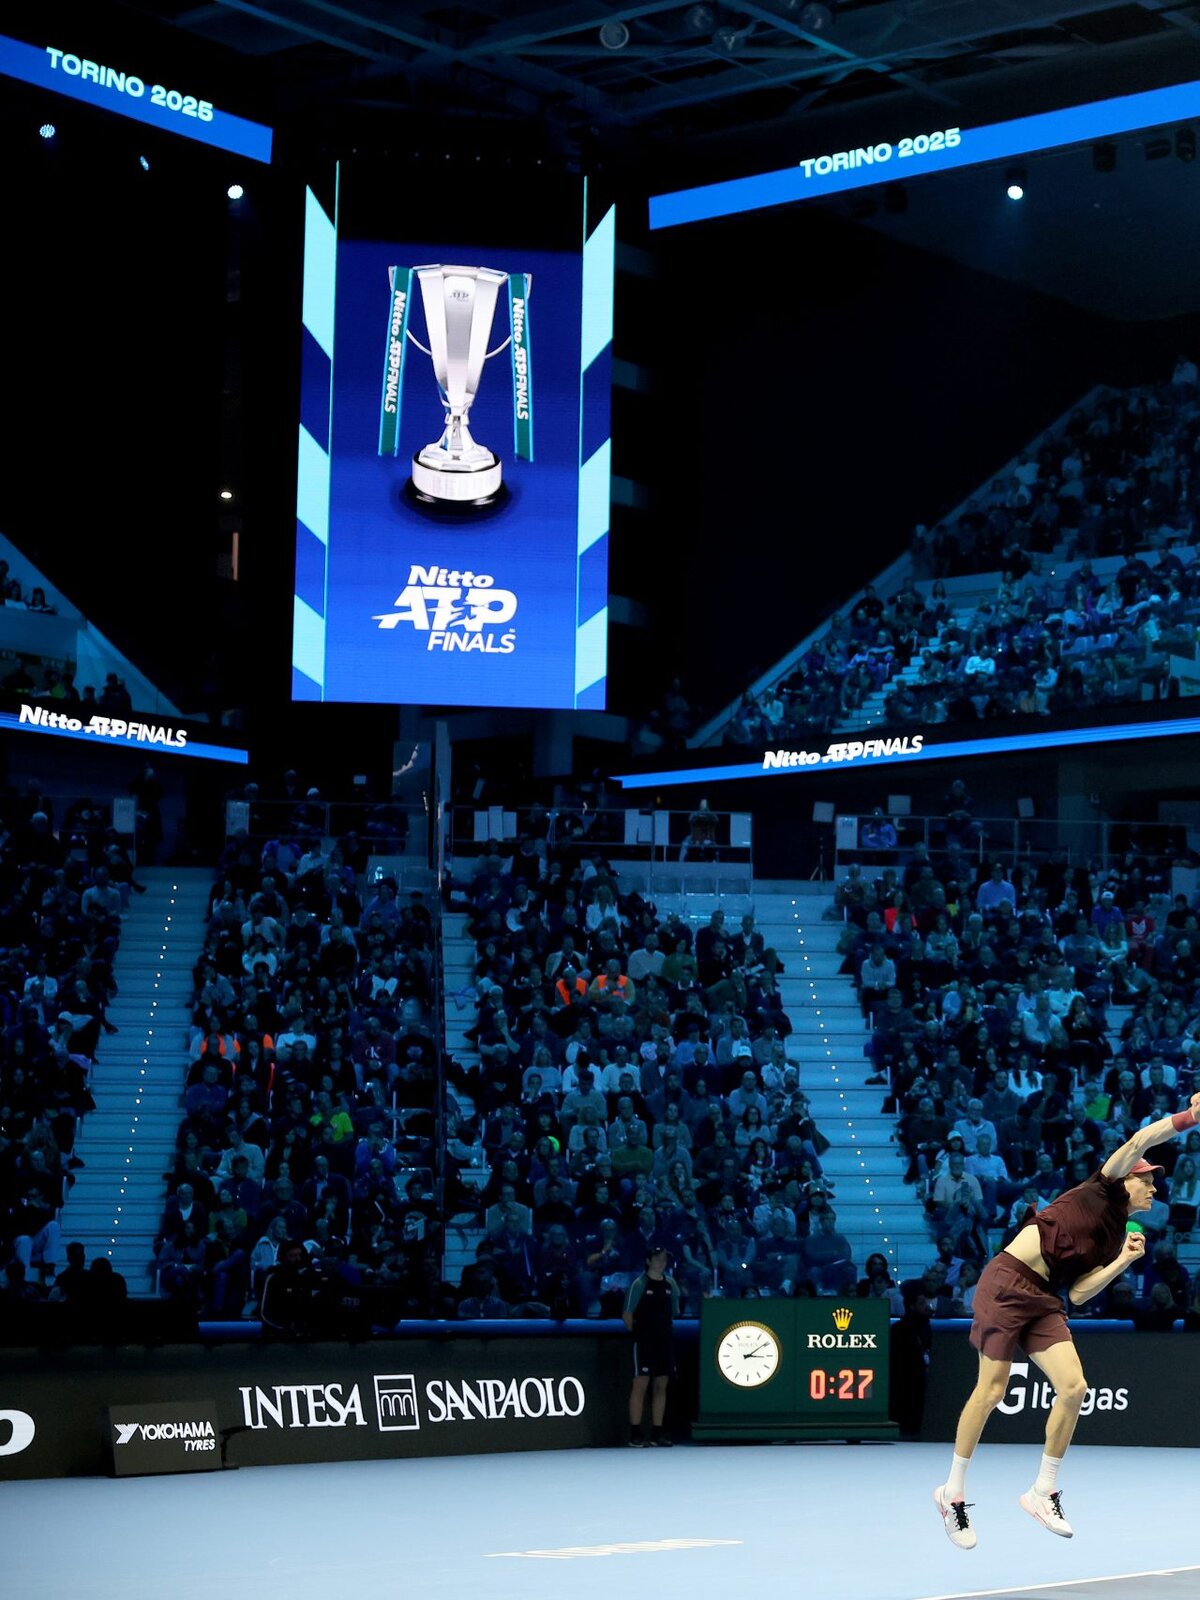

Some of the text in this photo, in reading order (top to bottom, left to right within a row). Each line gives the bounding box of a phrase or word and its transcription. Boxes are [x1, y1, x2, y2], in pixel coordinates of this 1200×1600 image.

[46, 46, 214, 122] TORINO 2025
[800, 127, 961, 178] TORINO 2025
[391, 290, 406, 336] Nitto
[512, 297, 525, 343] Nitto
[407, 565, 494, 588] Nitto
[372, 586, 518, 632] ATP
[427, 631, 516, 653] FINALS
[19, 704, 82, 731] Nitto
[762, 750, 821, 769] Nitto
[807, 1334, 877, 1349] ROLEX
[810, 1369, 873, 1400] 0:27
[1031, 1382, 1129, 1416] Itgas
[239, 1376, 585, 1429] INTESA SANPAOLO
[139, 1421, 215, 1441] YOKOHAMA
[184, 1438, 216, 1452] TYRES
